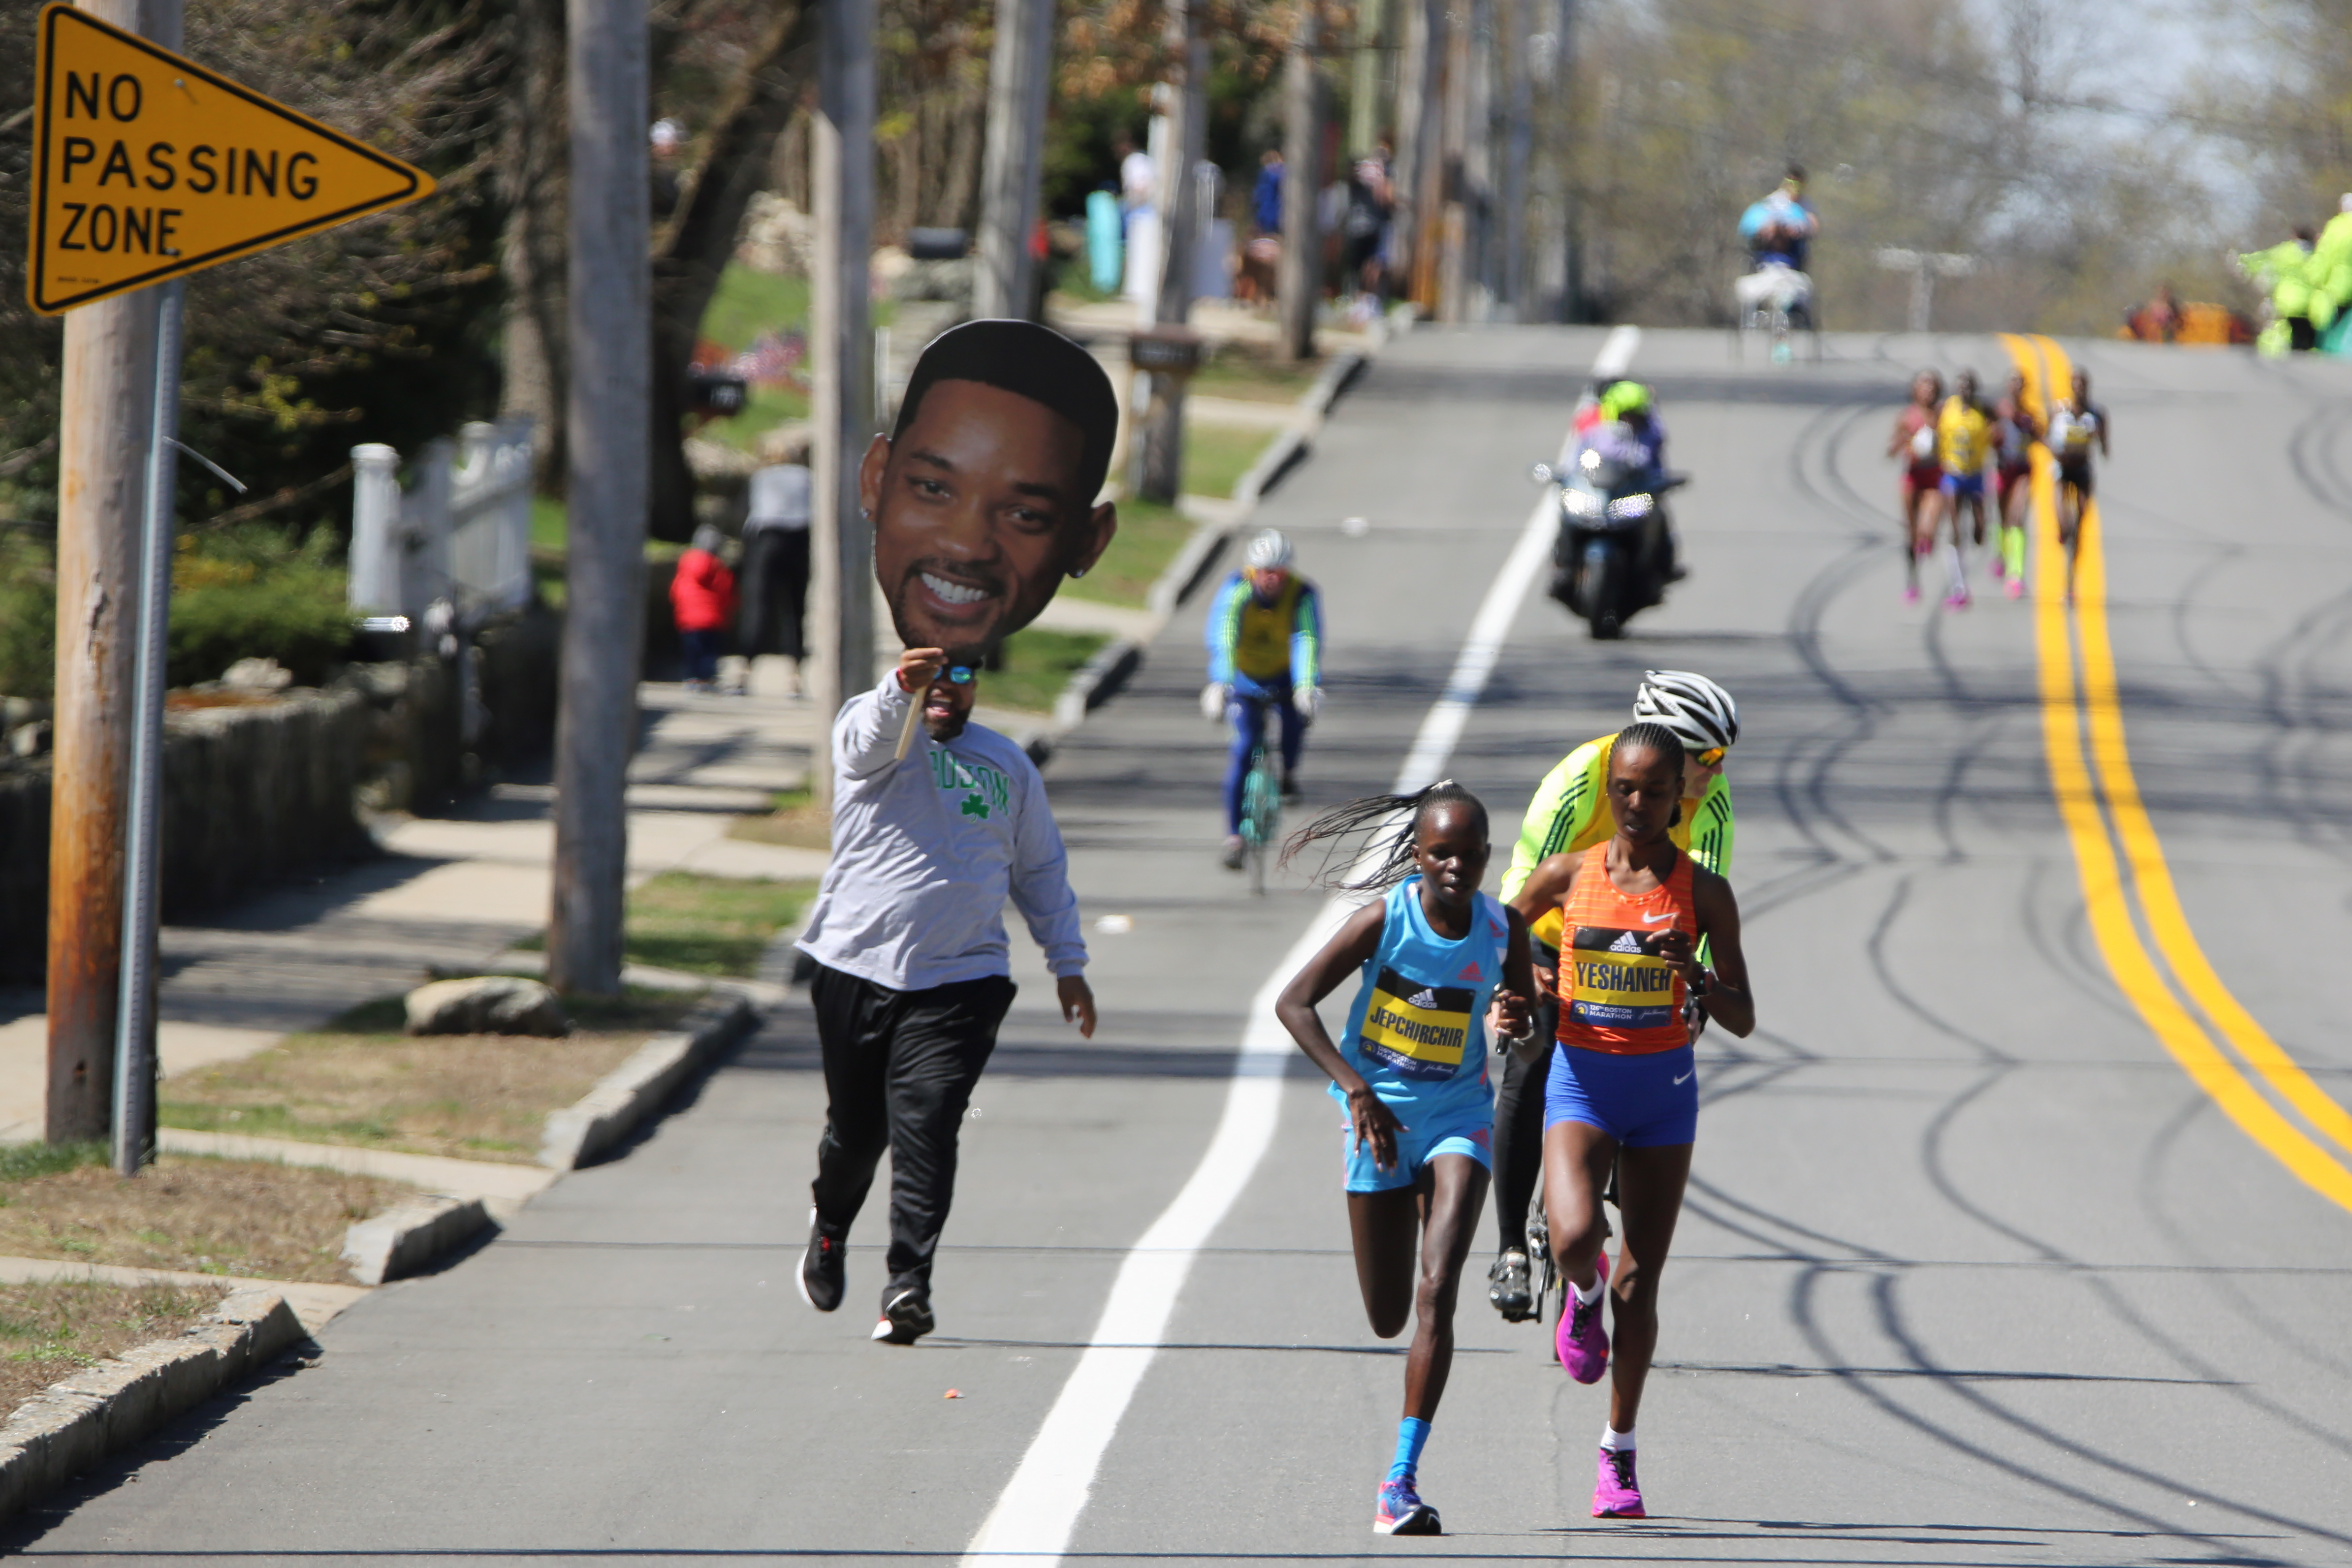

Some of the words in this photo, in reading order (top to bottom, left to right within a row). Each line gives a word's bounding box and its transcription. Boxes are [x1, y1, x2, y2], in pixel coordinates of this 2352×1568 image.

[65, 70, 143, 123] NO
[63, 136, 319, 200] PASSING
[59, 202, 183, 256] ZONE
[1610, 943, 1642, 953] adidas
[1576, 962, 1673, 992] YESHANEH
[1408, 997, 1437, 1009] adidas
[1589, 1010, 1632, 1019] MARATHON
[1370, 1006, 1464, 1048] JEPCHIRCHIR
[1377, 1051, 1415, 1071] MARATHON
[1392, 1051, 1417, 1066] BOSTON
